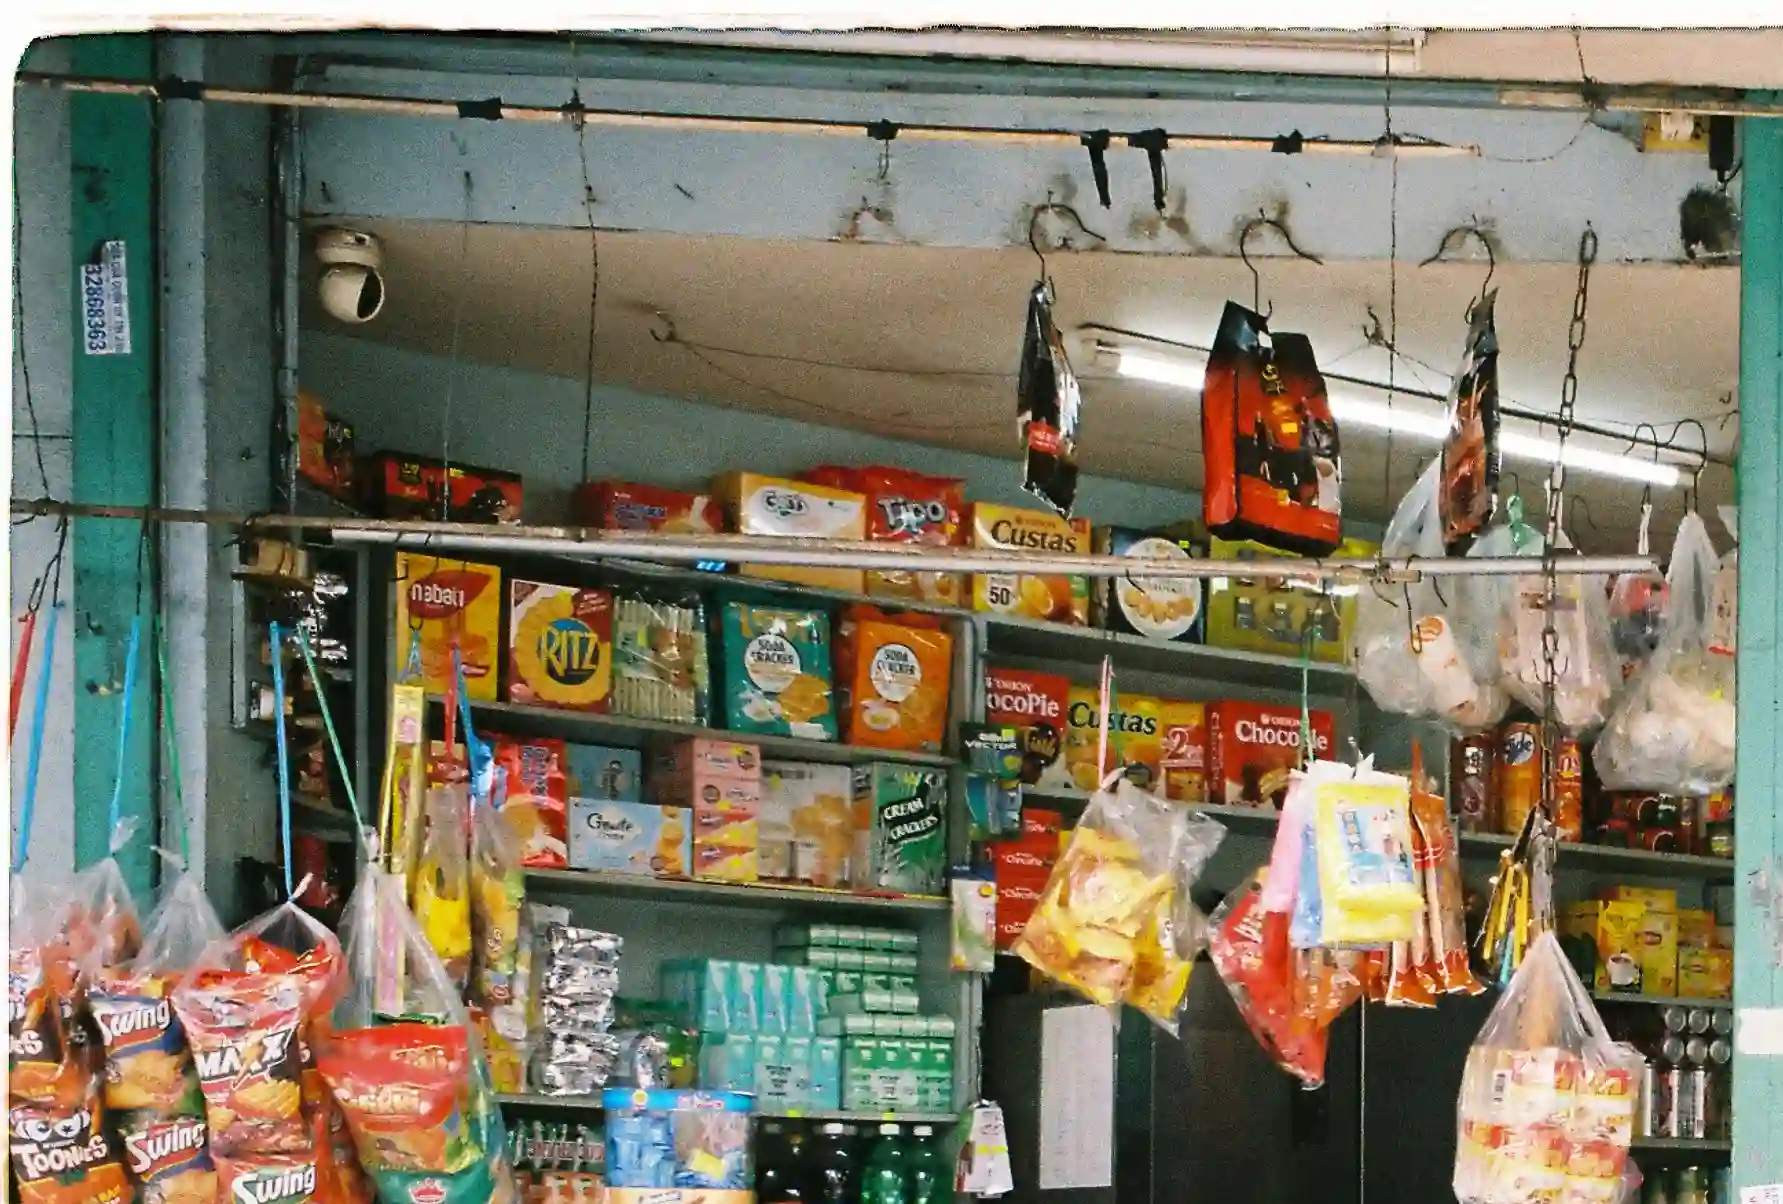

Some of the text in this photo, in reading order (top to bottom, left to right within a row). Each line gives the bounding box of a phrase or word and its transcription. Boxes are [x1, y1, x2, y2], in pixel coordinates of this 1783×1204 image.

[990, 520, 1077, 553] Custas
[988, 586, 1011, 605] 50
[540, 623, 600, 677] RITZ
[986, 693, 1061, 718] ocoPie
[125, 1122, 207, 1173] Swing
